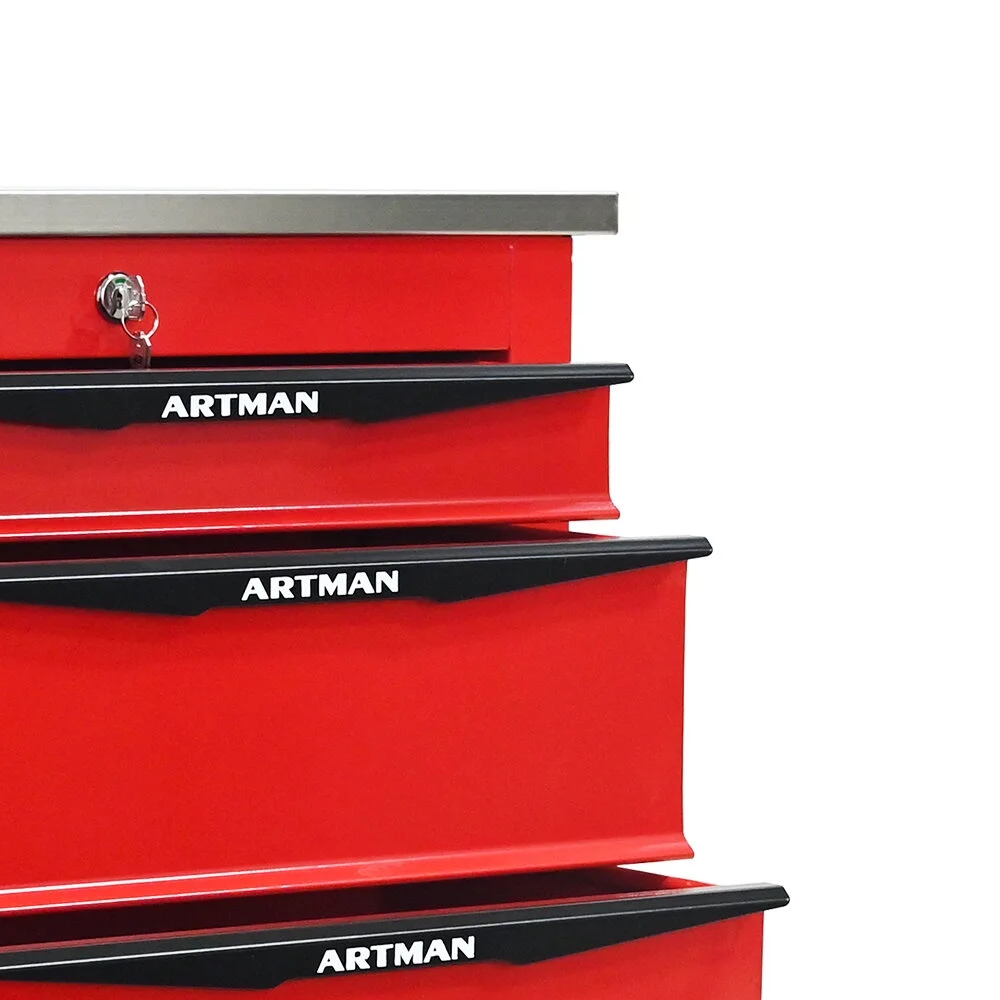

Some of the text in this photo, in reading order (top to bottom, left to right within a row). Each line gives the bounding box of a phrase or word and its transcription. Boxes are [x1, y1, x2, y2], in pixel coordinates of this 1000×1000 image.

[161, 391, 318, 418] ARTMAN
[241, 570, 398, 601] ARTMAN
[316, 936, 475, 973] ARTMAN
